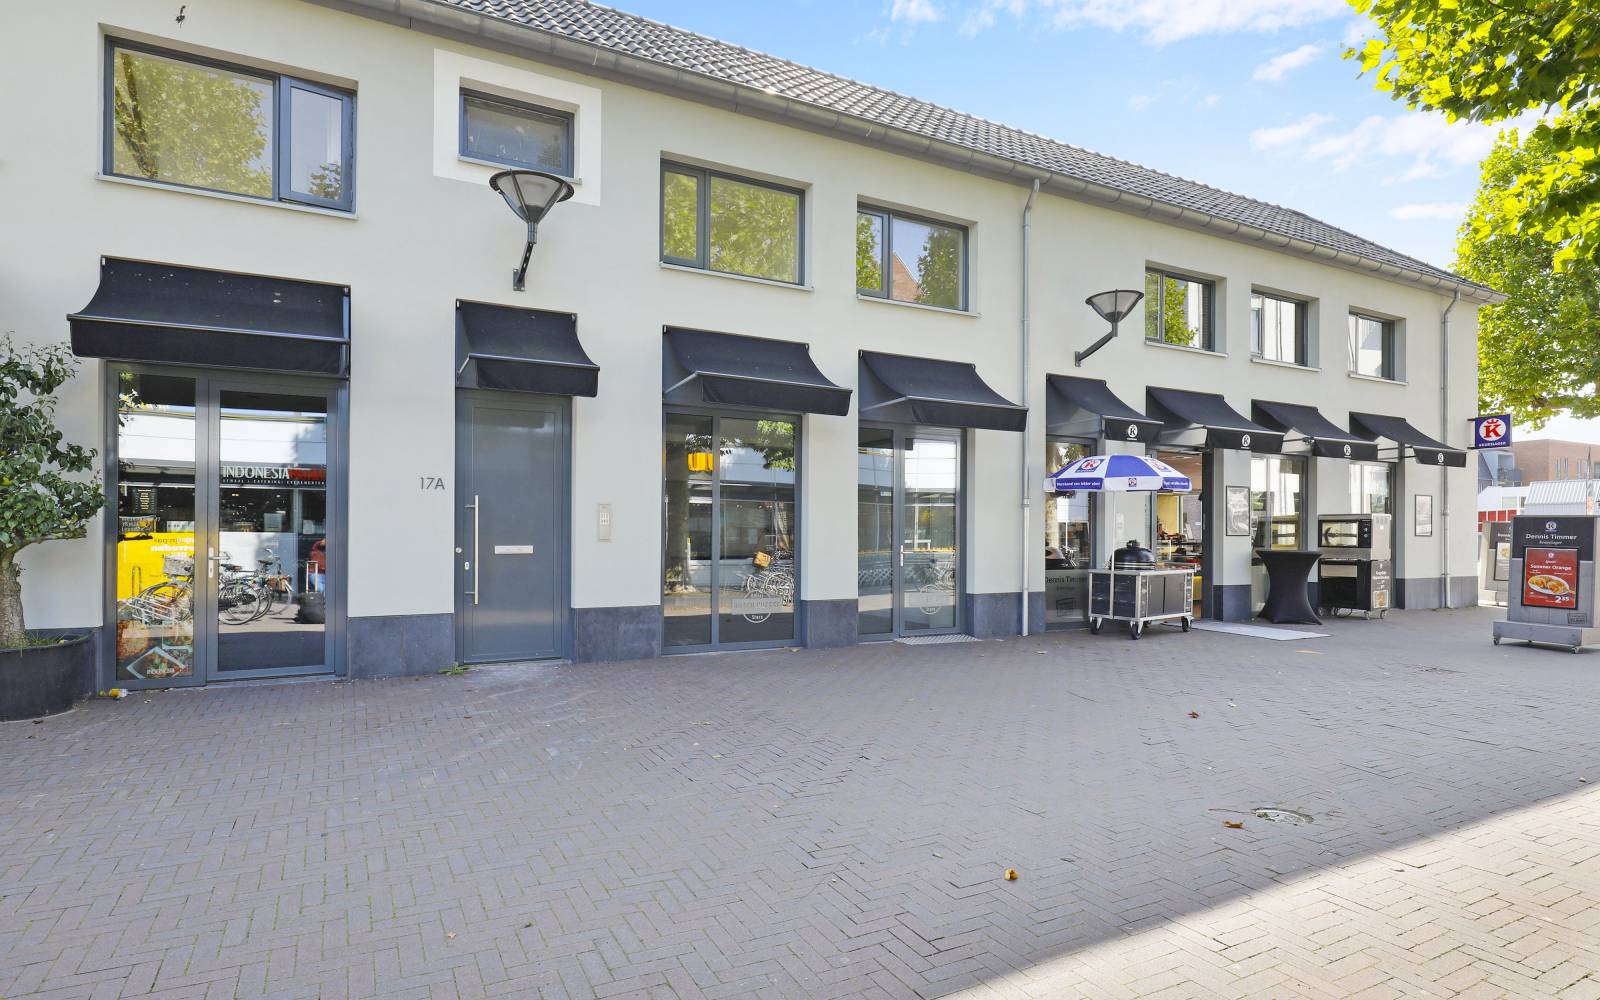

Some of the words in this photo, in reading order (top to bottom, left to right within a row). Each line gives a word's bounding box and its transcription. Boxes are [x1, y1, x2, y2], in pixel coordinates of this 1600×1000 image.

[1484, 424, 1501, 438] K
[223, 466, 289, 479] INDONESIA
[421, 477, 445, 490] 17A
